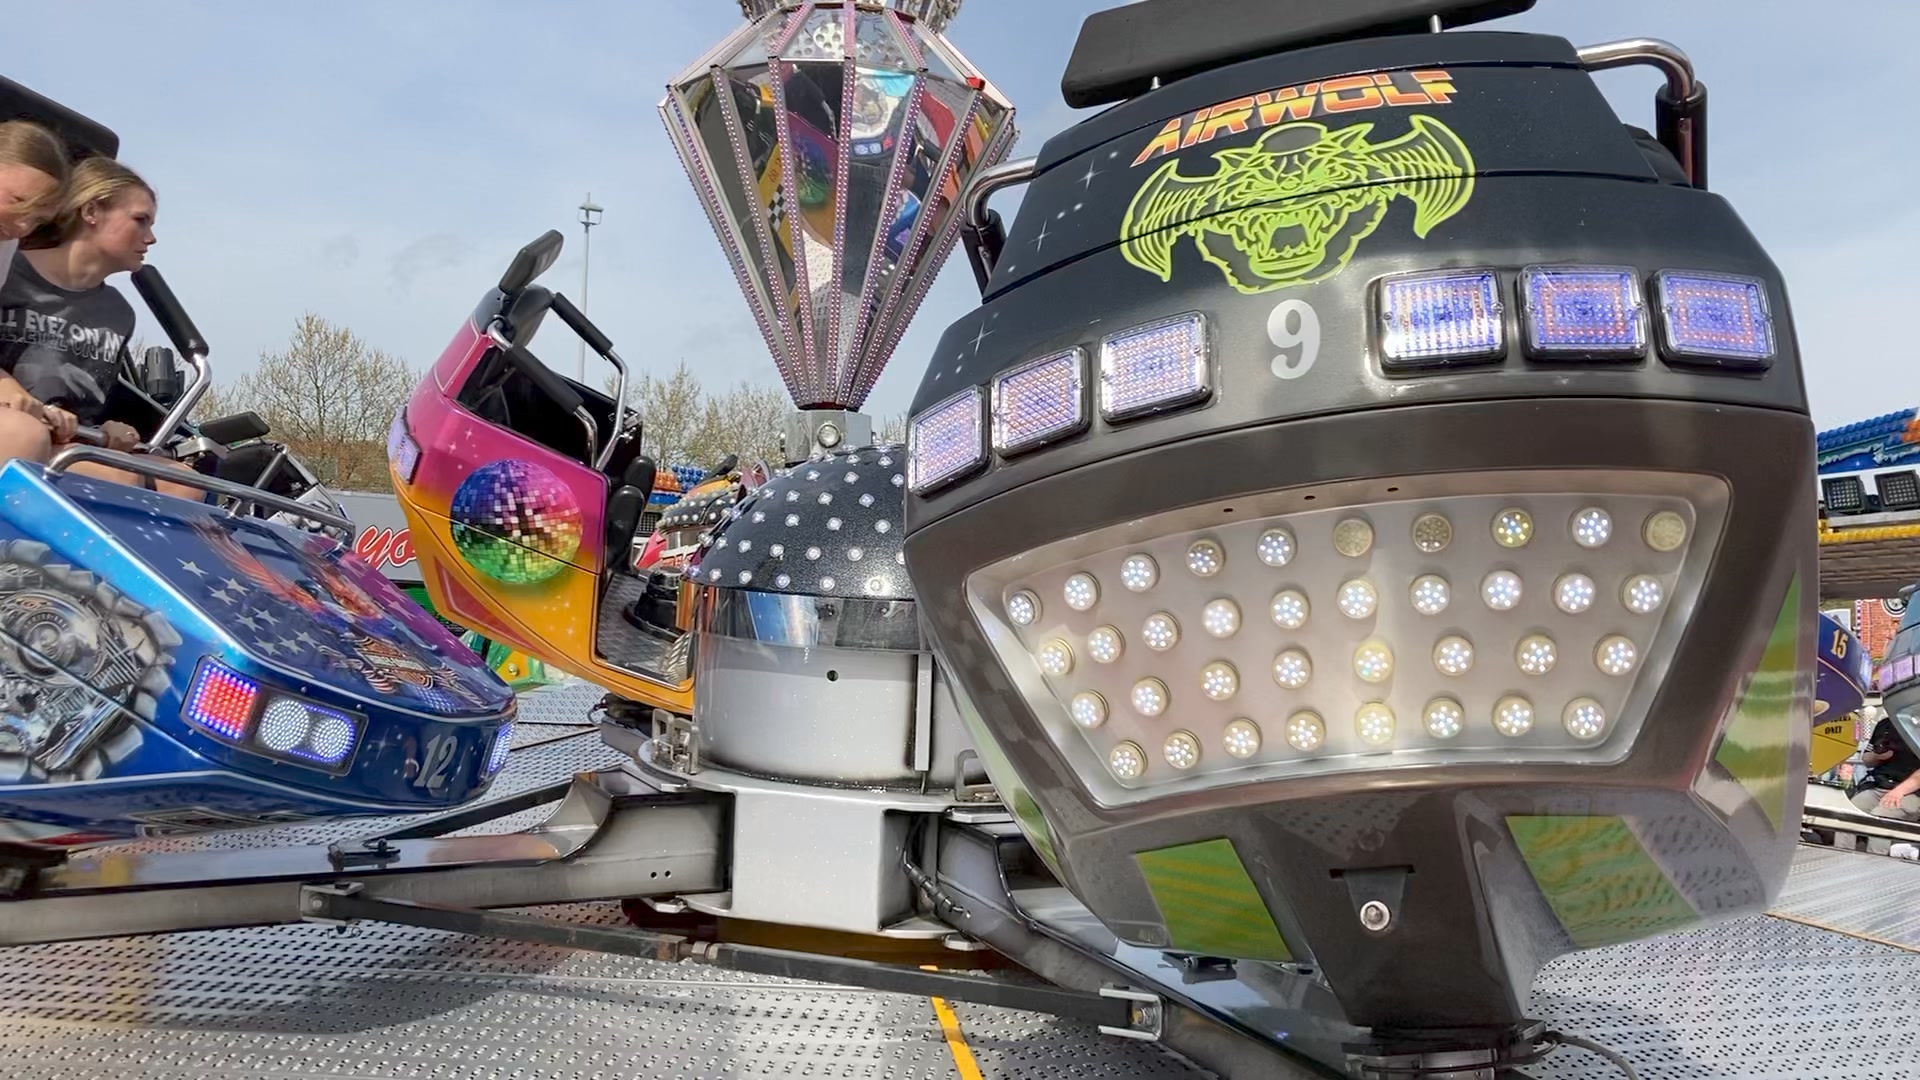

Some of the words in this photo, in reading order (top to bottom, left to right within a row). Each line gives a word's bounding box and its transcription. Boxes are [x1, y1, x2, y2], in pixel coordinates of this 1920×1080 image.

[1130, 70, 1458, 168] AIRWOLF
[25, 309, 67, 339] EYEZ
[69, 323, 101, 346] ON
[1267, 299, 1321, 379] 9
[1830, 629, 1849, 660] 15
[413, 734, 458, 788] 12
